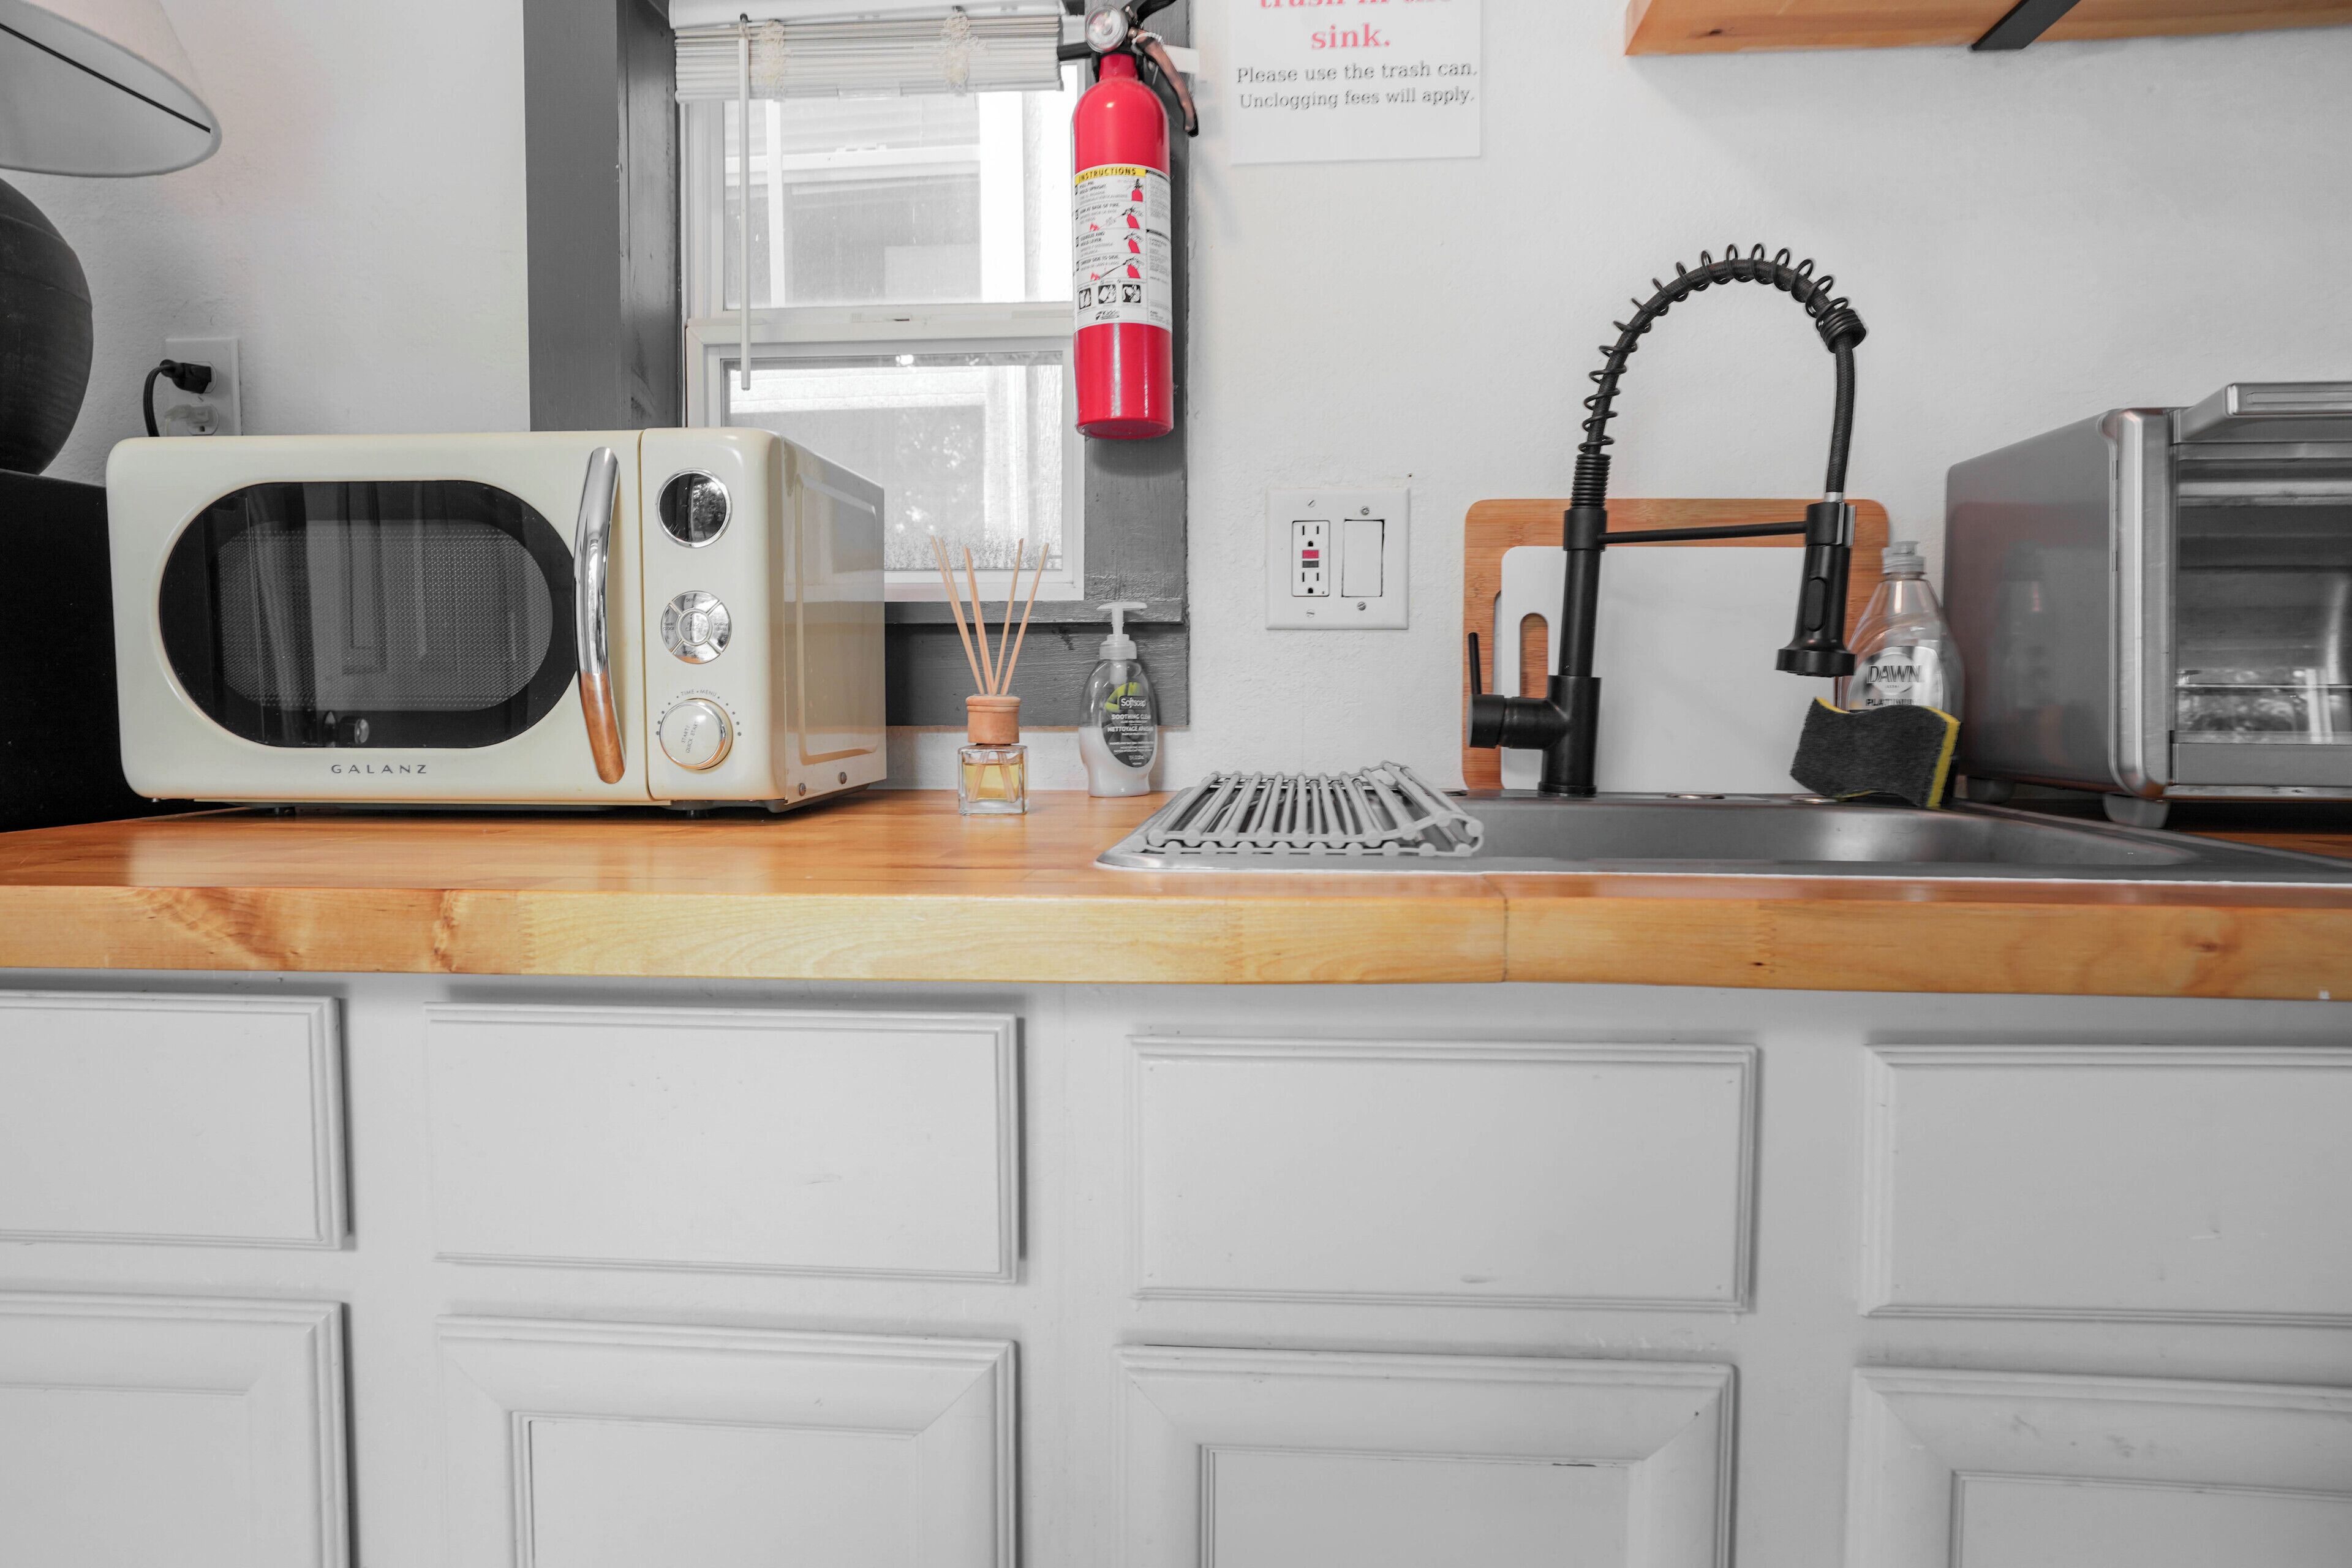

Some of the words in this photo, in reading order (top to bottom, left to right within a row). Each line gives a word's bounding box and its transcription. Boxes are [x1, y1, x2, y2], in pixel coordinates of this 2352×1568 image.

[1311, 23, 1391, 49] sink.
[1236, 67, 1298, 84] Please
[1305, 67, 1337, 81] use
[1344, 63, 1374, 80] the
[1382, 61, 1431, 78] trash
[1437, 62, 1477, 77] can.
[1239, 91, 1339, 110] Unclogging
[1344, 89, 1379, 105] fees
[1386, 88, 1417, 103] will
[1422, 86, 1475, 106] apply.
[1078, 167, 1136, 181] INSTRUCTIONS
[1867, 665, 1922, 682] DAWN
[331, 764, 427, 774] GALANZ
